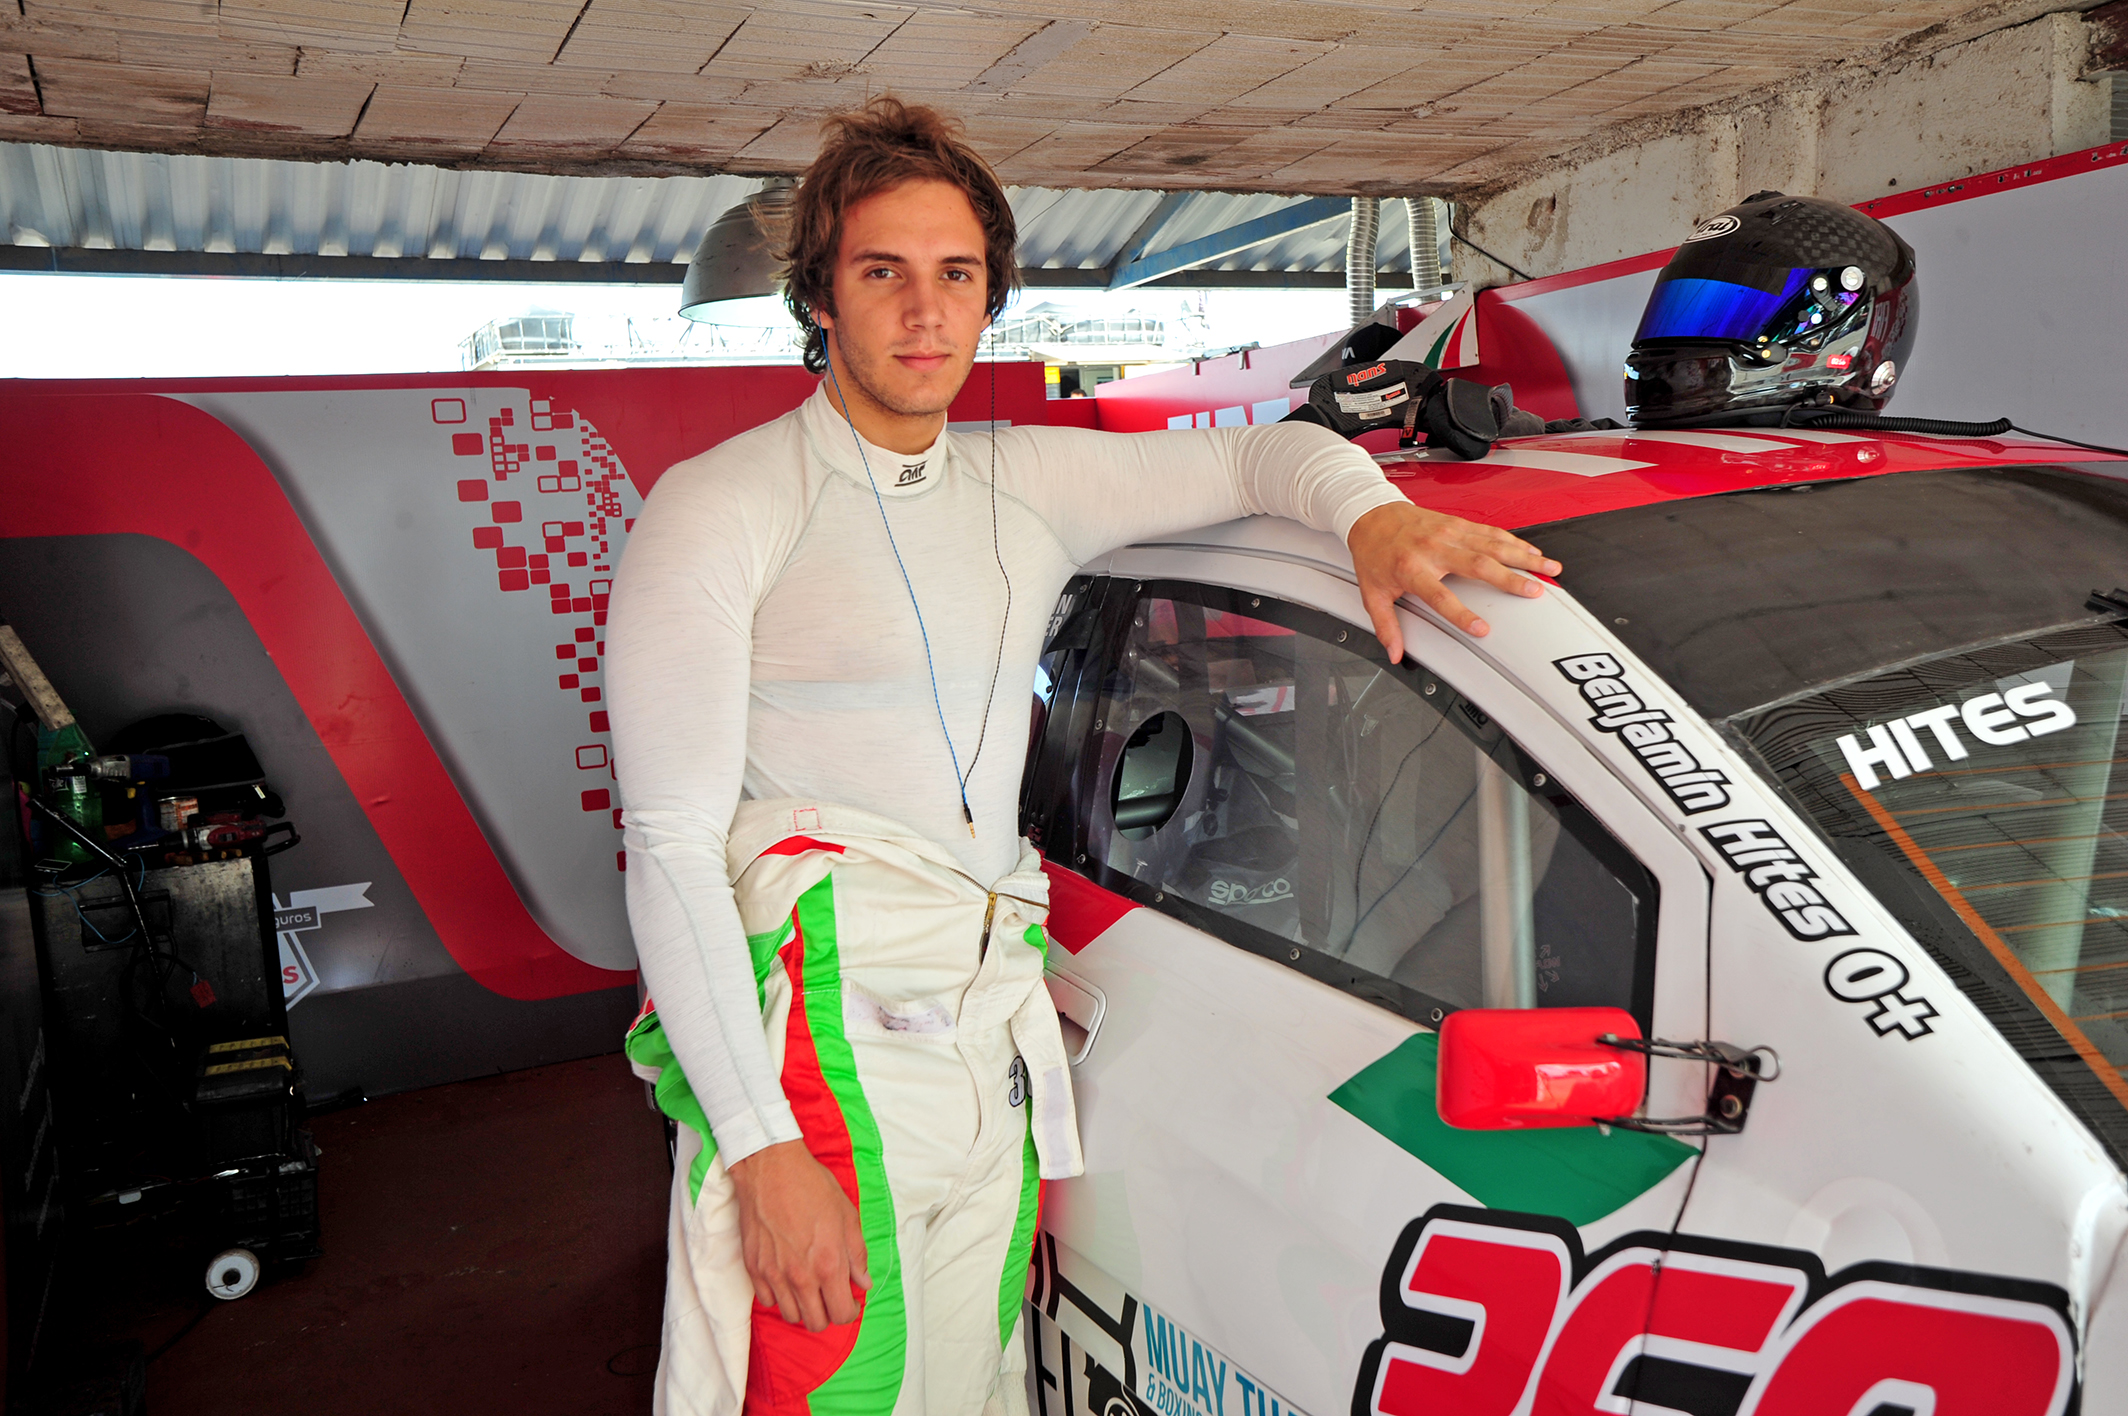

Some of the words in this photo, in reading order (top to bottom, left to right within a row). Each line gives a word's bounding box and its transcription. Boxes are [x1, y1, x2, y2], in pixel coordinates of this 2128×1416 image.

[1836, 681, 2077, 791] HITES
[1698, 819, 1859, 942] Hites
[1143, 1303, 1226, 1416] MUAY
